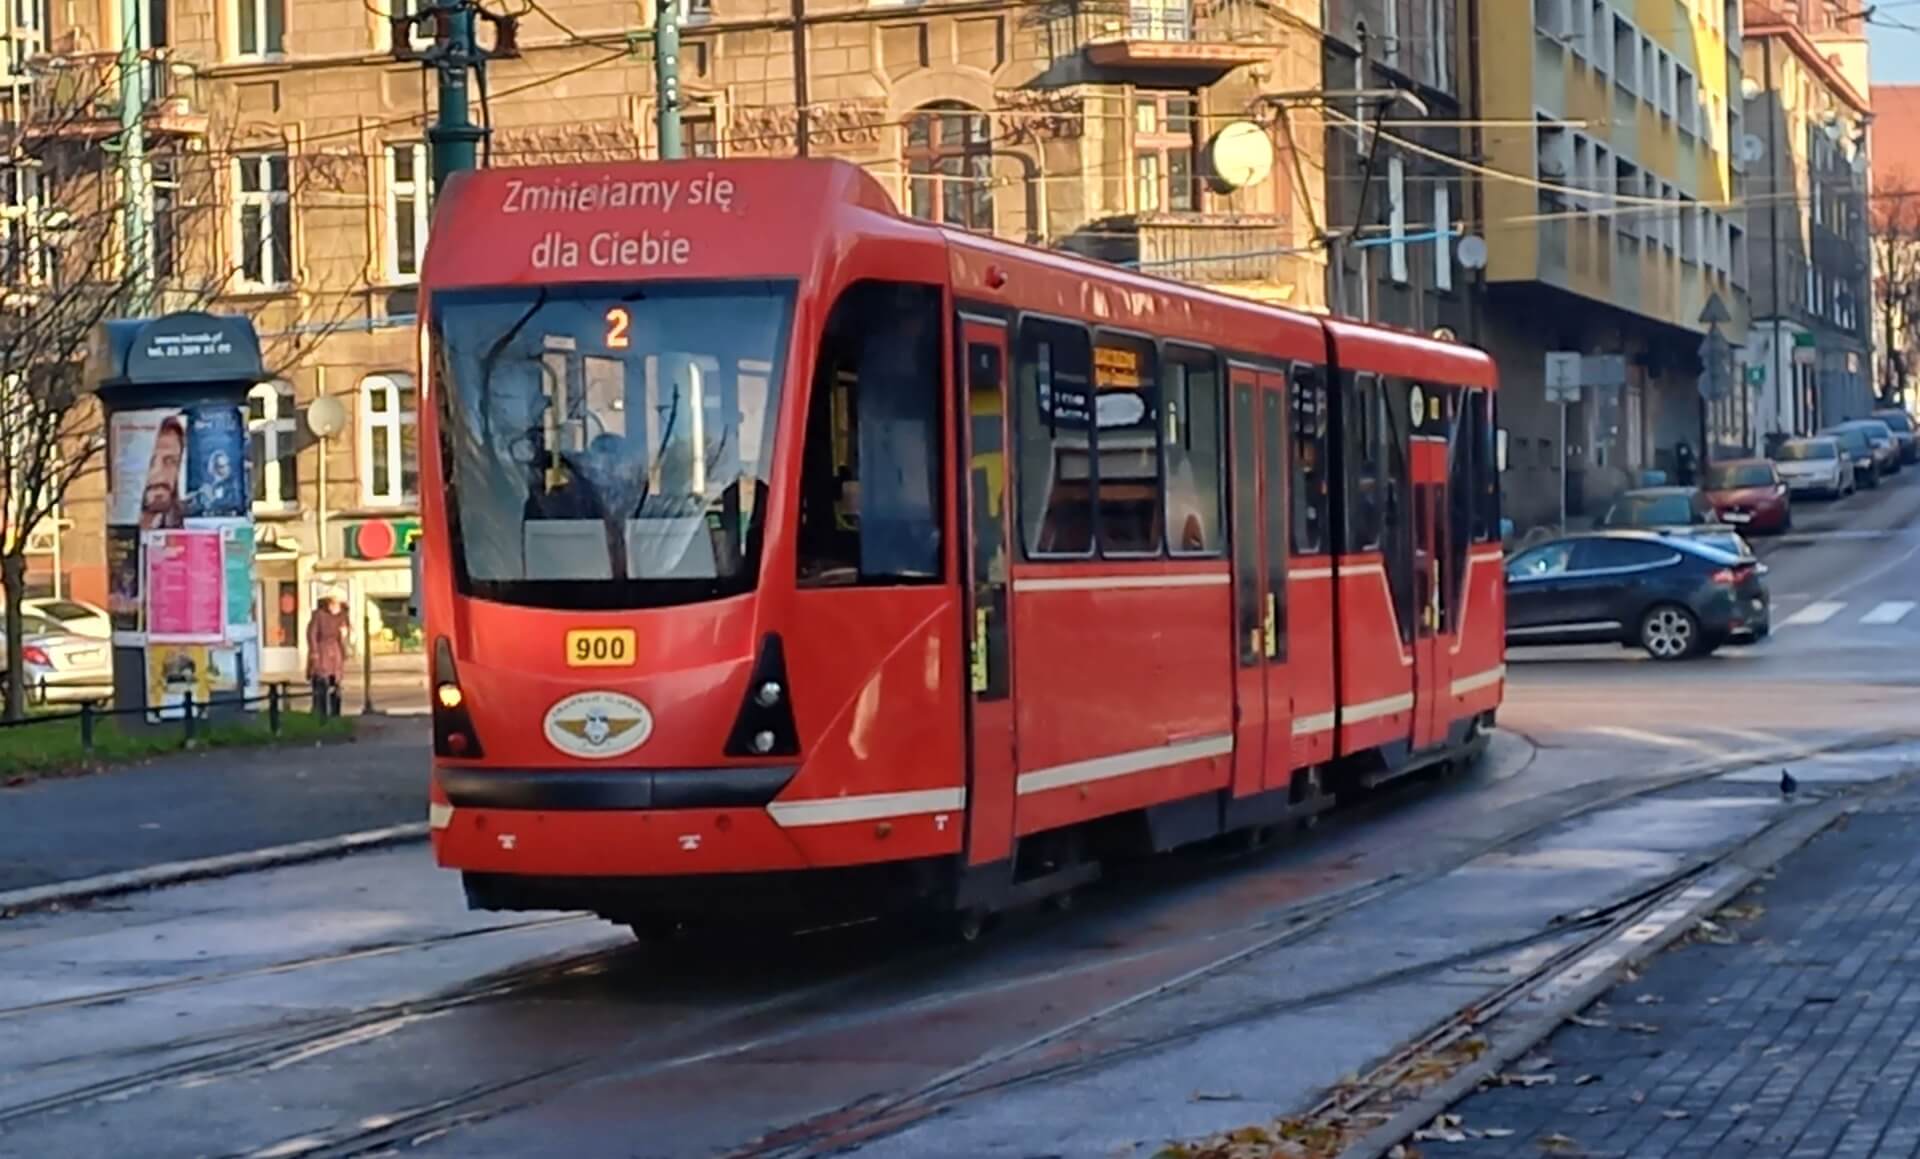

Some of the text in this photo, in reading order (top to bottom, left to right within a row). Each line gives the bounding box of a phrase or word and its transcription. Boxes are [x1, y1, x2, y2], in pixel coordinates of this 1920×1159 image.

[687, 171, 735, 213] się
[531, 229, 691, 269] dla Ciebie
[605, 307, 630, 349] 2
[576, 636, 625, 660] 900
